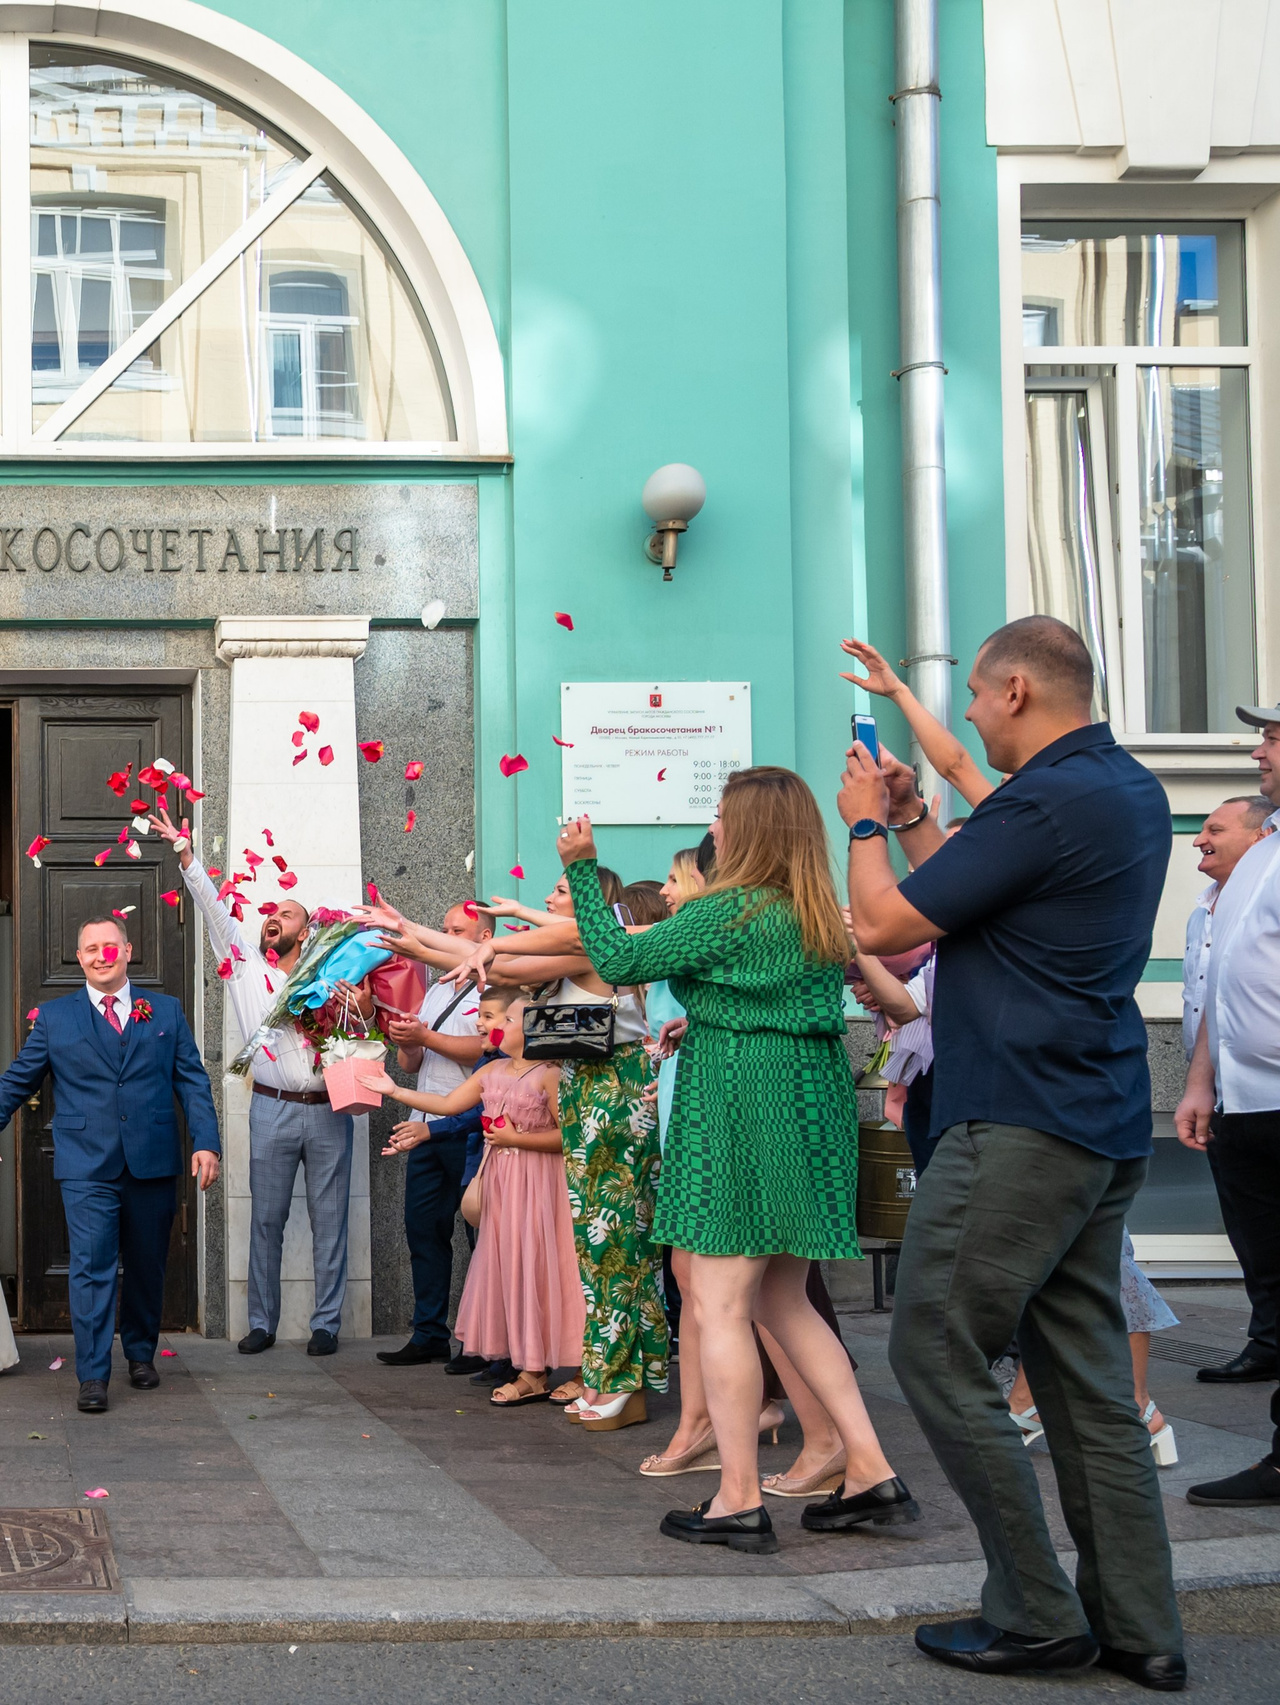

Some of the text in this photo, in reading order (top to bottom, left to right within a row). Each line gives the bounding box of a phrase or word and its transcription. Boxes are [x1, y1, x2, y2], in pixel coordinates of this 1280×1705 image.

[590, 726, 626, 735] Дворец
[627, 725, 702, 735] бракосочетания
[625, 749, 689, 757] РЕЖИМ РАБОТЫ
